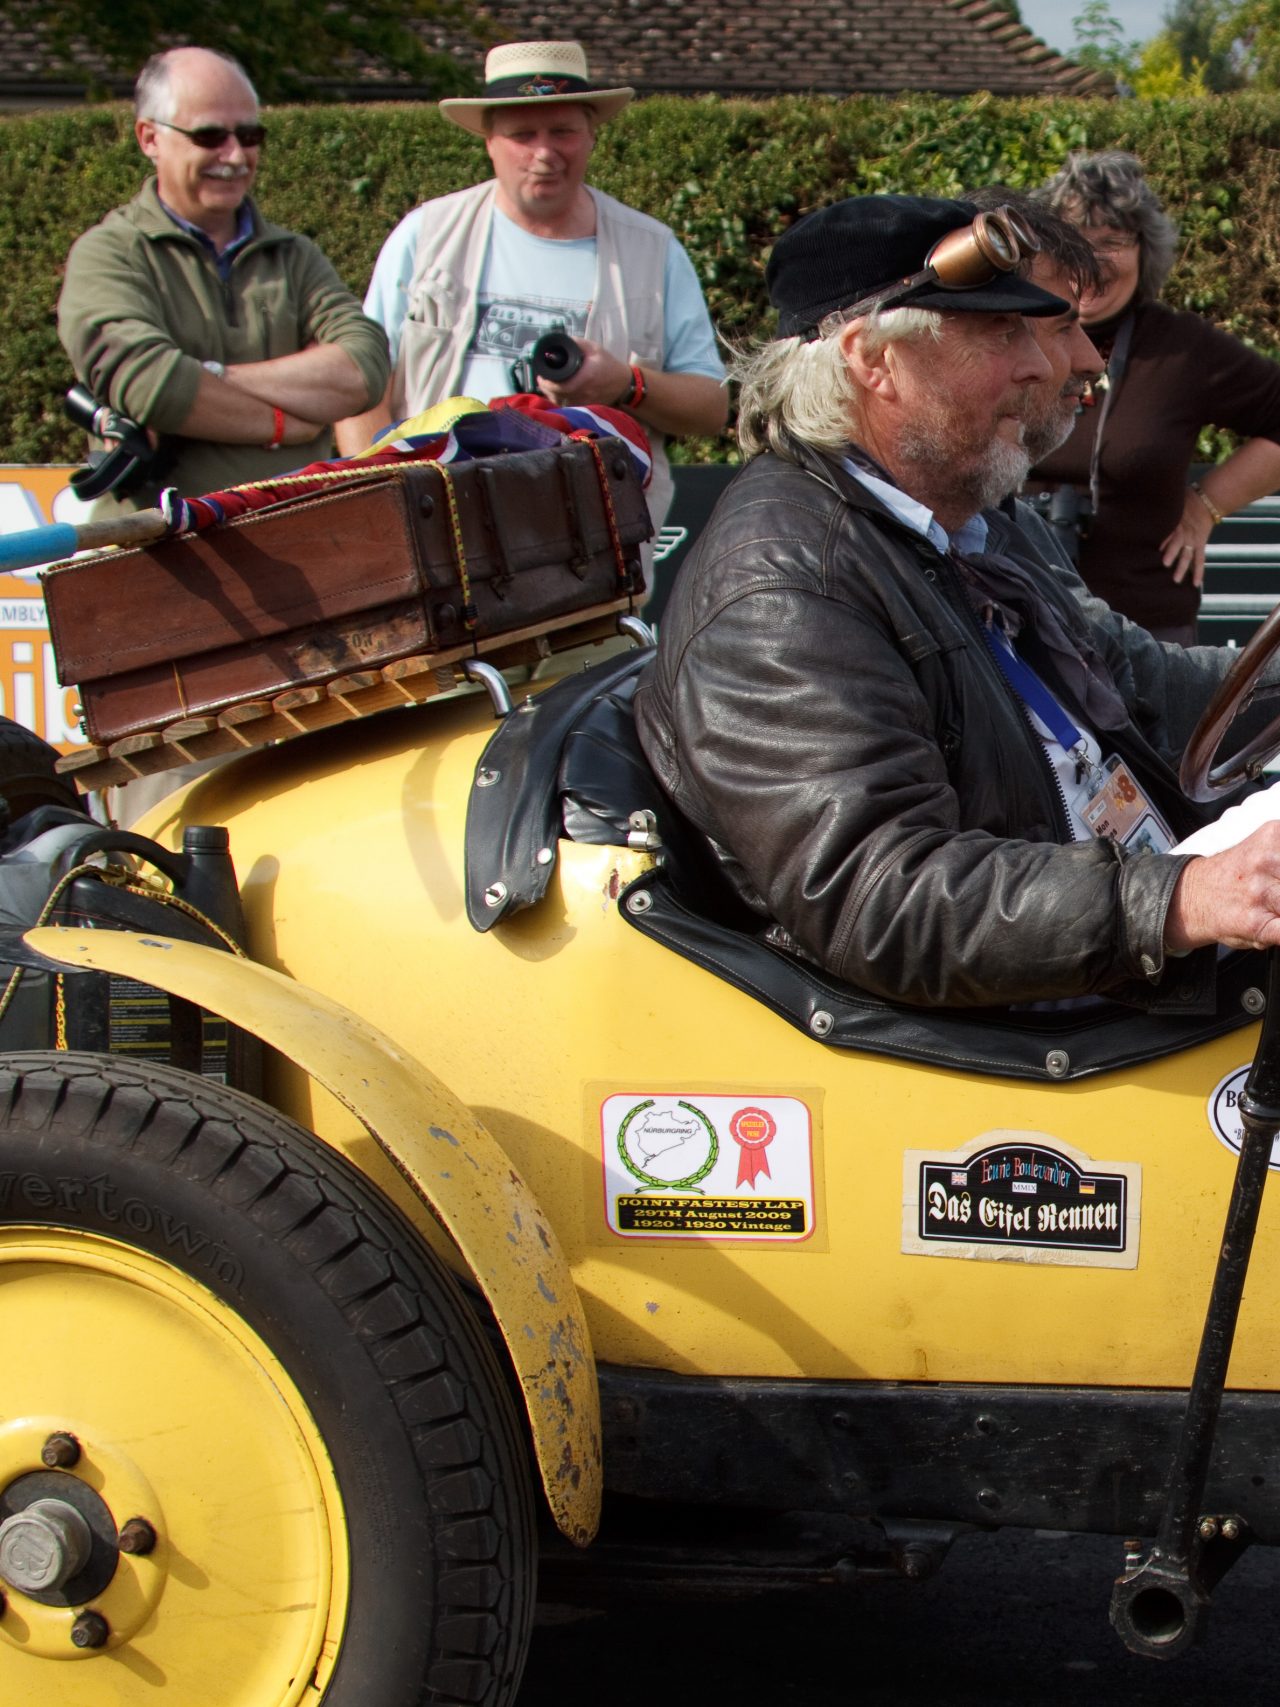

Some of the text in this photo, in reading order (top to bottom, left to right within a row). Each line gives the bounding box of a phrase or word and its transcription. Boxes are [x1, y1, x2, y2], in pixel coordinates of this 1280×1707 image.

[643, 1127, 693, 1135] NÜRBURGRING
[981, 1152, 1071, 1188] Ecurie Boulevardier
[619, 1199, 803, 1209] JOINT FASTEST LAP
[928, 1181, 1118, 1237] Das Eifel Rennen
[634, 1209, 791, 1220] 29TH August 2009
[633, 1219, 674, 1228] 1920
[685, 1220, 727, 1229] 1930
[729, 1221, 792, 1232] Vintage
